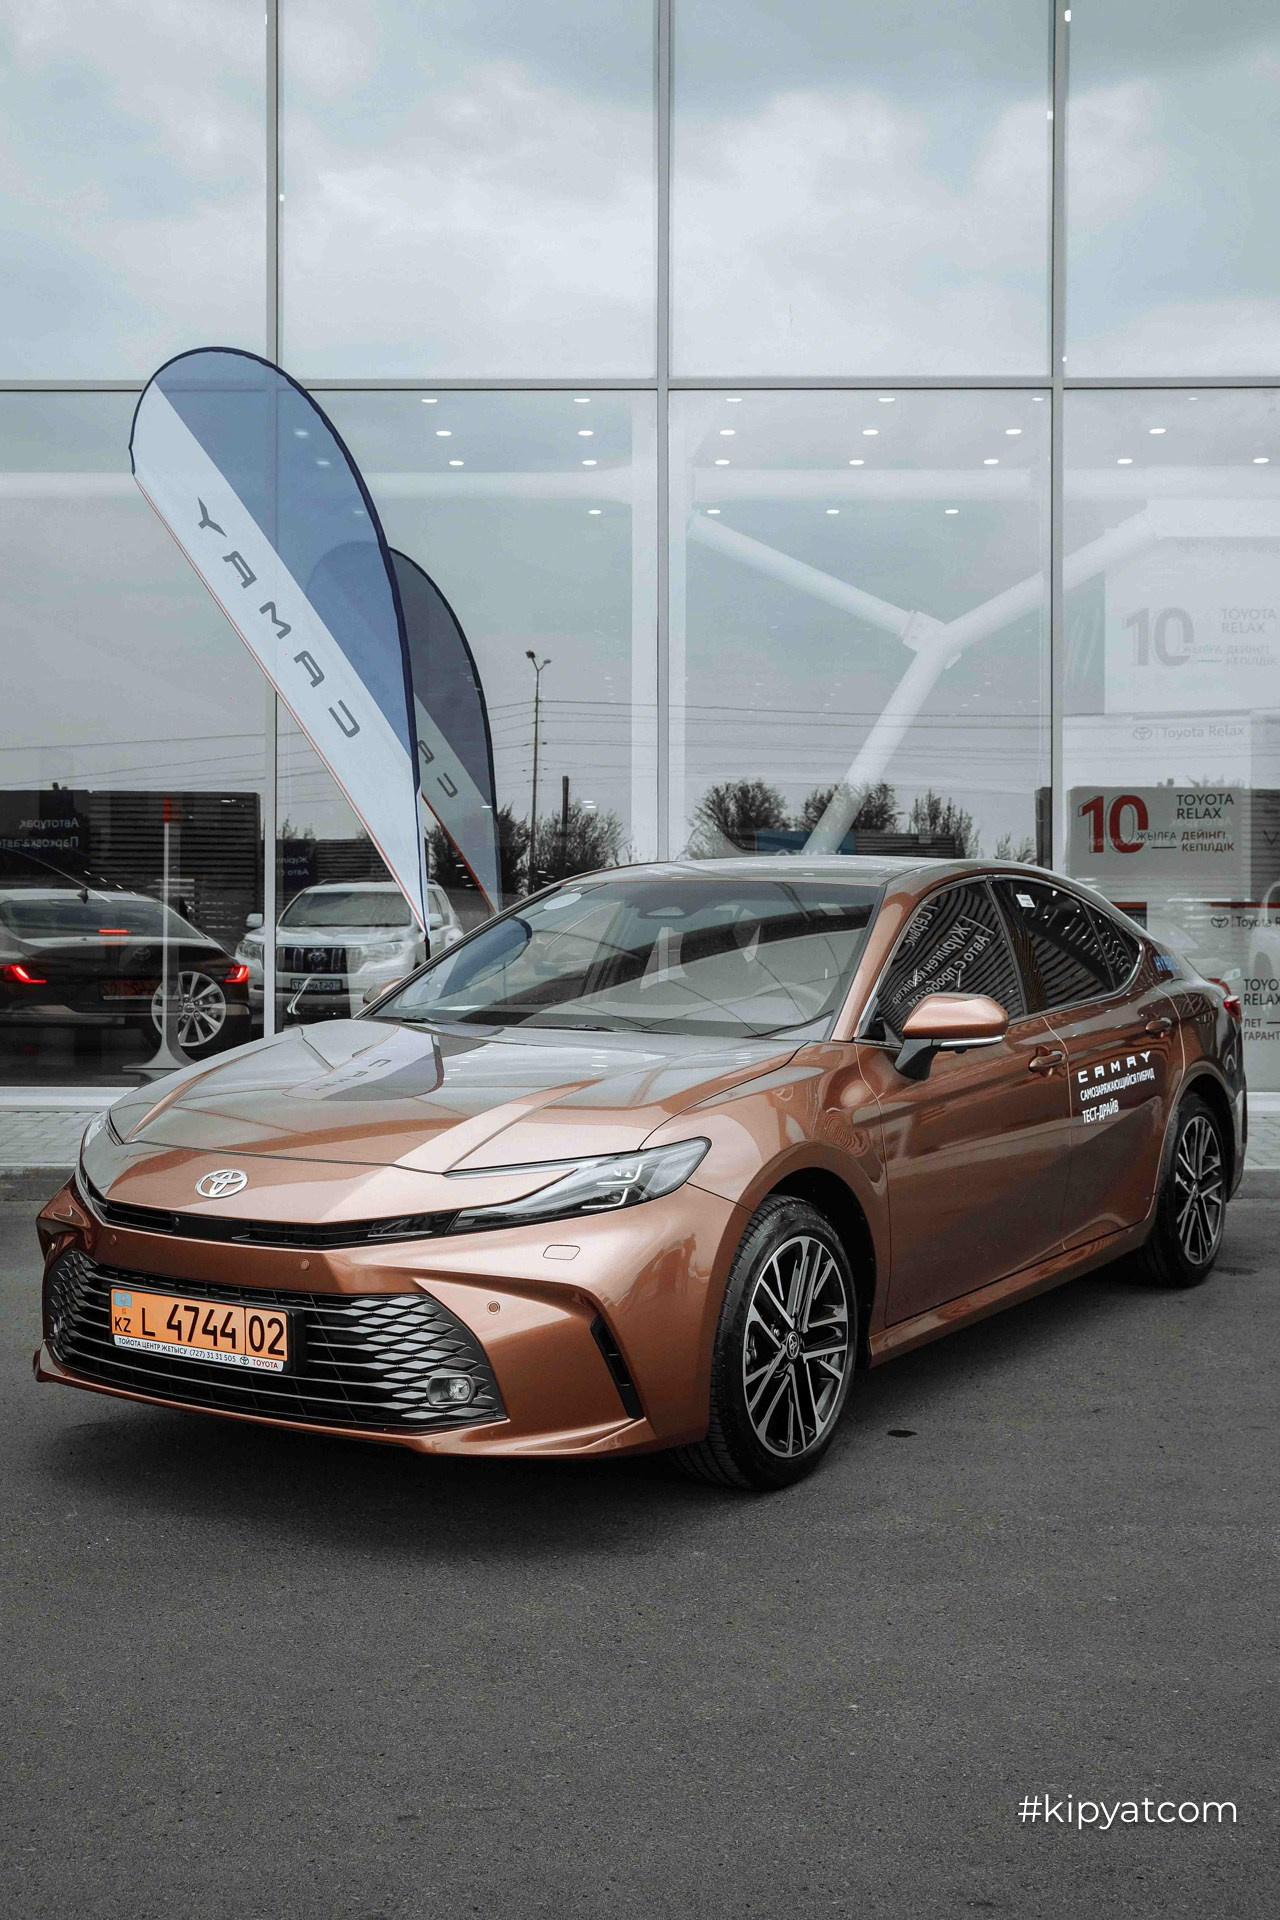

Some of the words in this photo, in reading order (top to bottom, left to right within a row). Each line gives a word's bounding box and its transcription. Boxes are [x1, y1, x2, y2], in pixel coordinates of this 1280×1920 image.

[1221, 608, 1277, 620] TOYOTA
[1221, 622, 1265, 634] RELAX
[1122, 606, 1194, 667] 10
[1162, 727, 1204, 740] Toyota
[1209, 724, 1245, 737] Relax
[1176, 793, 1235, 806] TOYOTA
[1176, 808, 1222, 820] RELAX
[1078, 794, 1149, 854] 10
[1181, 842, 1235, 853] КЕПІЛДІК
[1243, 978, 1280, 992] TOYO
[1244, 1018, 1262, 1028] ЛЕТ
[1080, 1072, 1137, 1102] САМОЗАРЯЖАЮЩИЙСЯ
[1136, 1067, 1156, 1086] ГИБРИД
[1082, 1097, 1119, 1124] ТЕСТ-ДРАЙВ
[114, 1316, 132, 1333] KZ
[141, 1307, 156, 1337] L
[166, 1303, 237, 1350] 4744
[248, 1314, 285, 1357] 02
[118, 1337, 142, 1348] ТОЙОТА
[141, 1340, 161, 1351] ЦЕНТР
[161, 1344, 188, 1355] ЖЕТЫСУ
[189, 1349, 206, 1359] (727)
[206, 1350, 214, 1359] 31
[214, 1352, 223, 1361] 31
[224, 1353, 237, 1363] 505
[252, 1358, 278, 1369] TOYOTA
